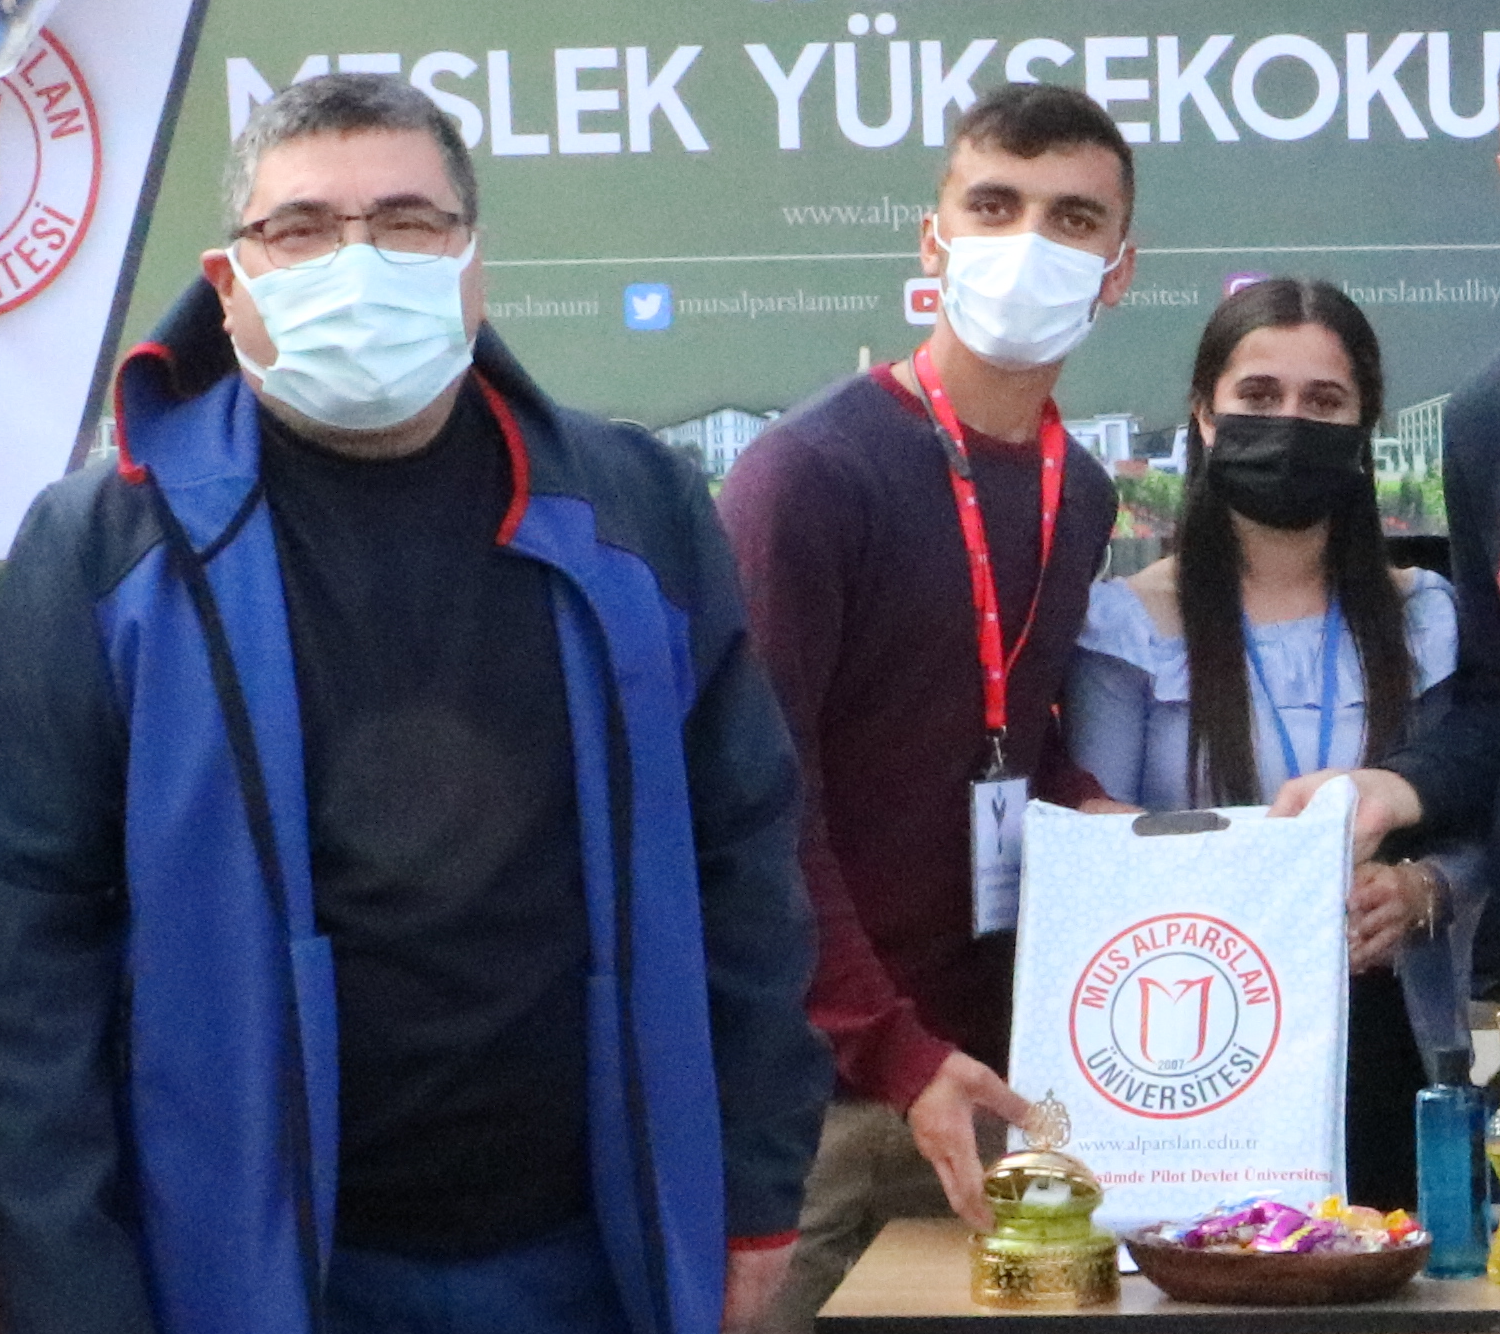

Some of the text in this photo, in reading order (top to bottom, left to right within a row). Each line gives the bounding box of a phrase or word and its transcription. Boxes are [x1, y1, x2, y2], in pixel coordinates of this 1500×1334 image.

[225, 43, 710, 156] MSLEK
[678, 288, 882, 320] musalparslanunv
[1117, 280, 1200, 308] ersitesi
[1131, 922, 1272, 1006] ALPARSLAN
[1086, 1041, 1262, 1111] ÜNİVERSİTESİ
[1078, 1132, 1260, 1155] www.alparslan.edu.tr
[1150, 1169, 1186, 1184] Pilot
[1191, 1167, 1239, 1183] Devlet
